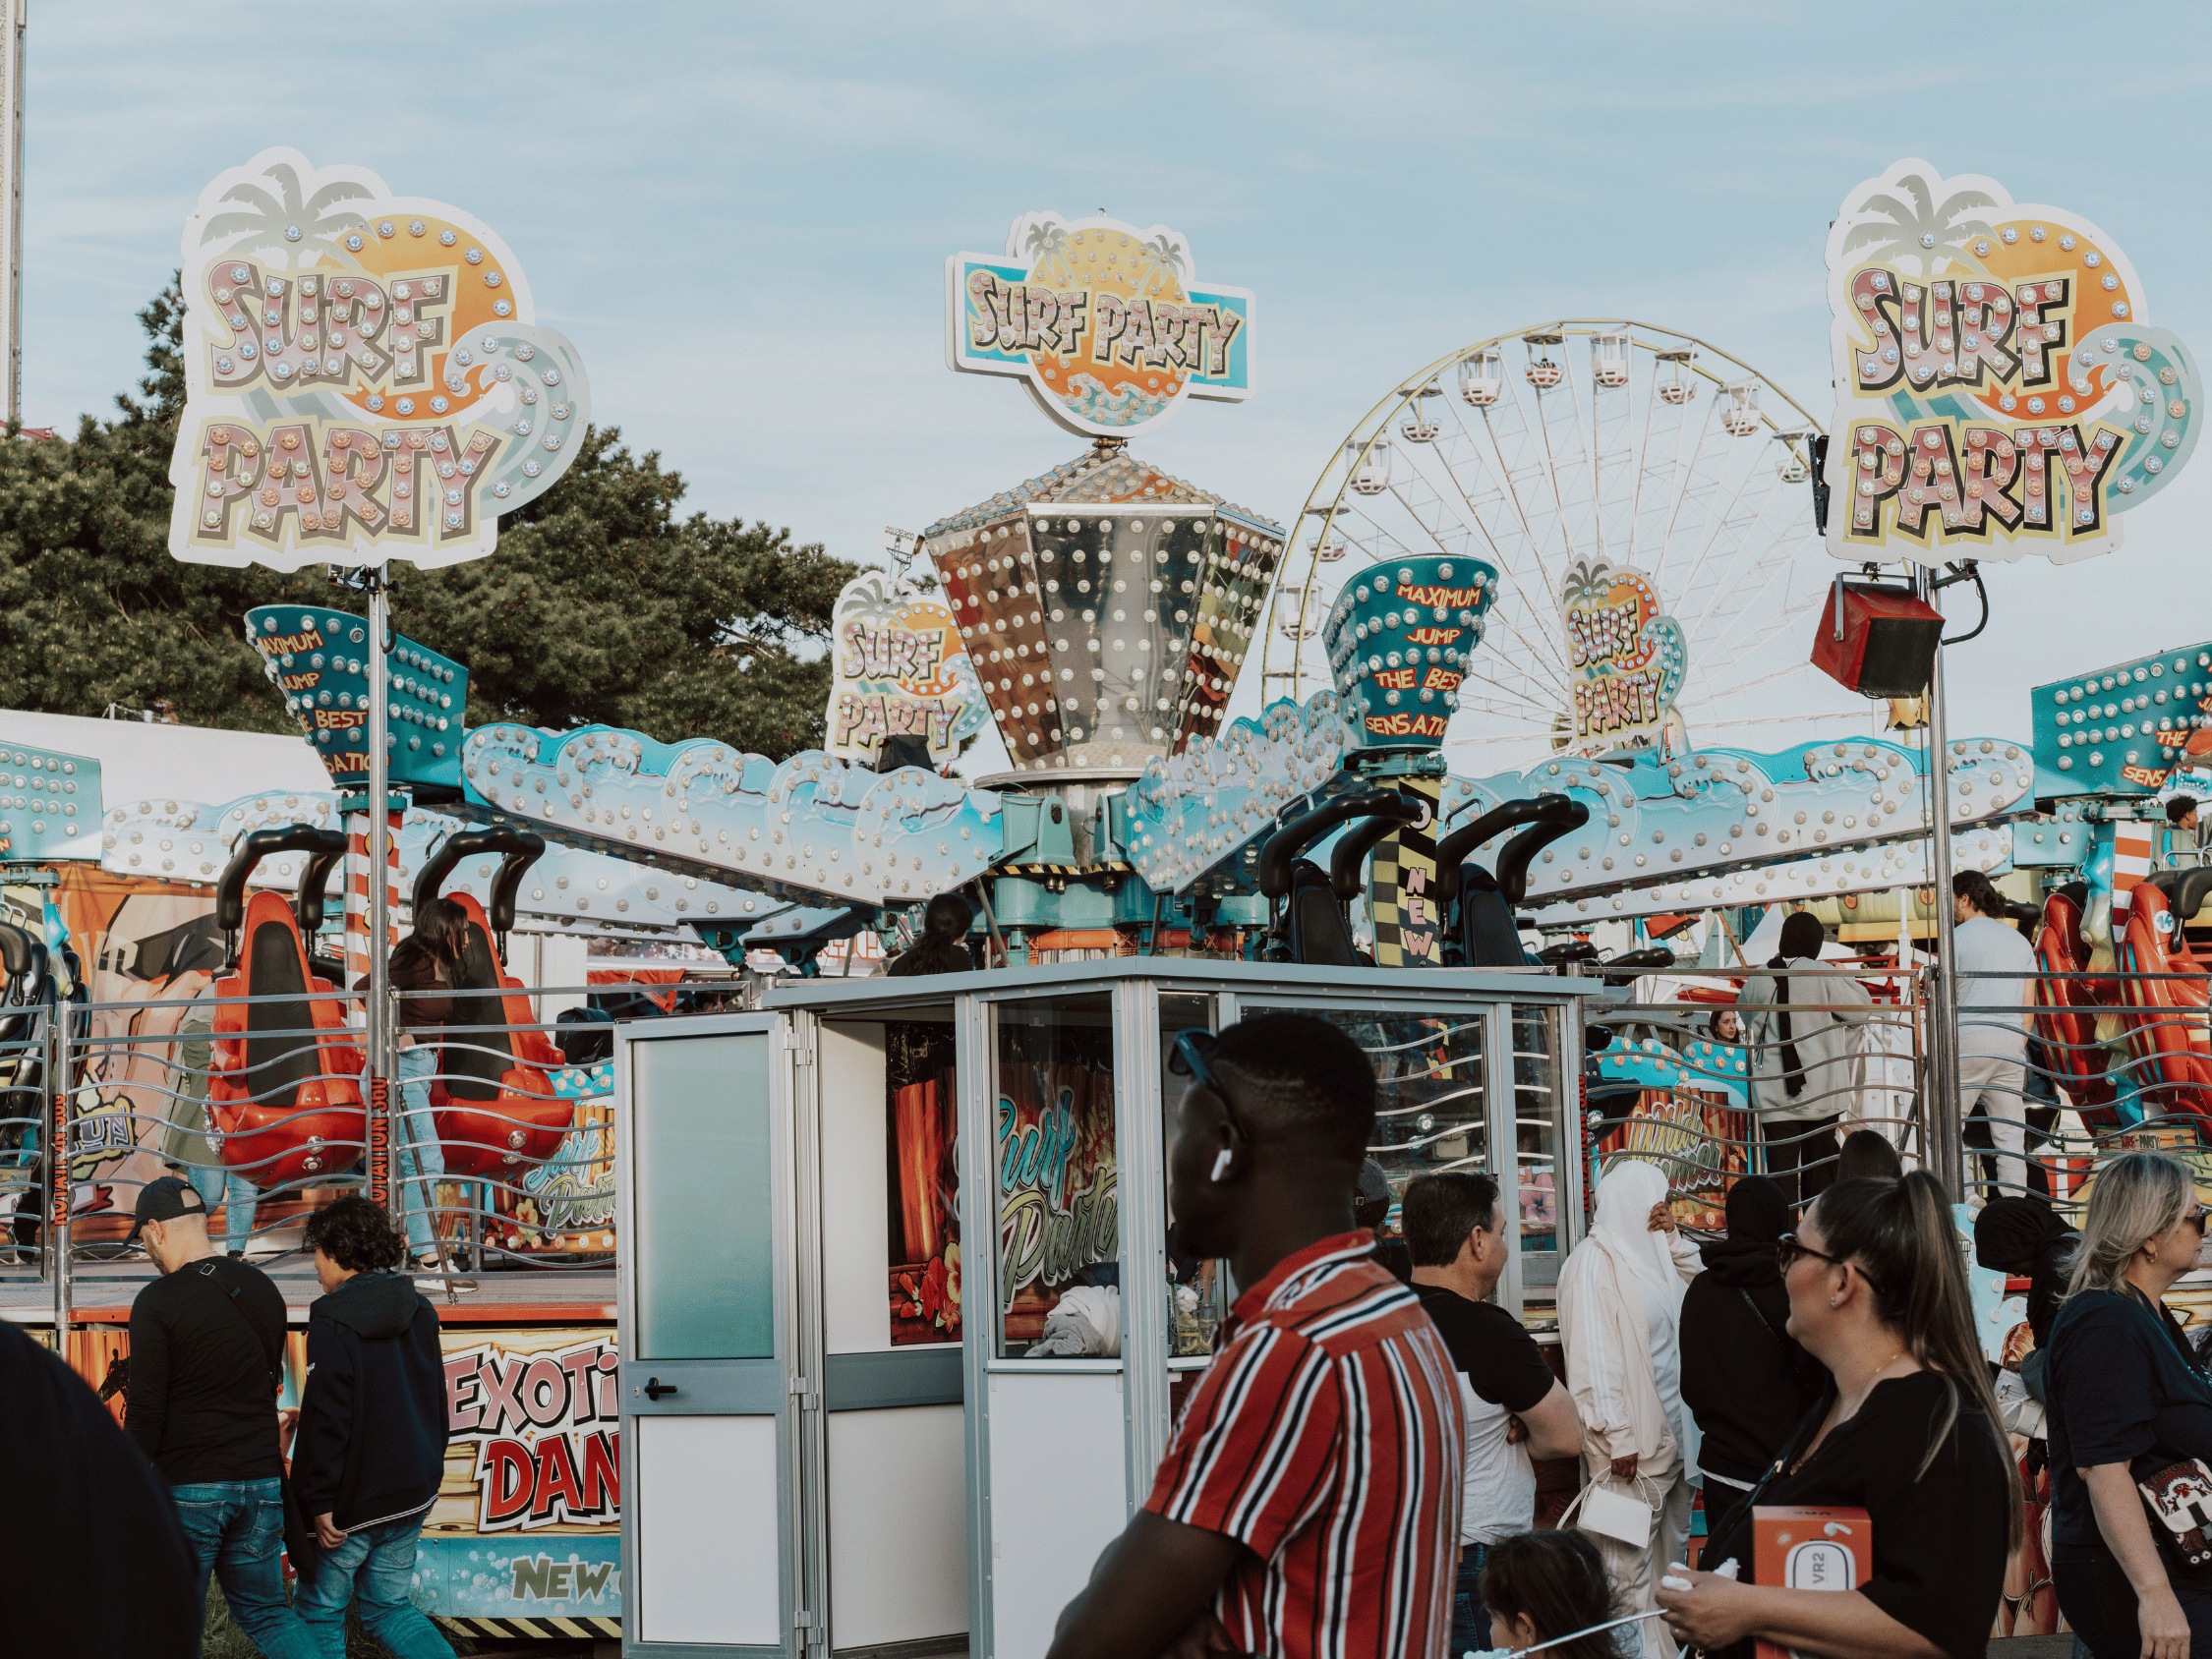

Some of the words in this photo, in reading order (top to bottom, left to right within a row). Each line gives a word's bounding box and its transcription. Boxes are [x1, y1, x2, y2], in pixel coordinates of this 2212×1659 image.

[206, 259, 450, 390] SURF
[968, 272, 1087, 355] SURF
[1094, 294, 1241, 375] PARTY
[1851, 267, 2069, 392] SURF
[198, 423, 502, 543] PARTY
[1852, 424, 2125, 539] PARTY
[1396, 584, 1483, 608] MAXIMUM
[843, 621, 943, 680] SURF
[1404, 628, 1463, 646] JUMP
[1568, 599, 1637, 668] SURF
[1372, 667, 1419, 689] THE
[1576, 669, 1662, 736] PARTY
[313, 709, 369, 729] BEST
[836, 694, 962, 750] PARTY
[2154, 729, 2189, 748] THE
[1404, 867, 1433, 956] NEW
[2156, 912, 2174, 930] 14
[372, 1116, 389, 1208] OTATION
[510, 1555, 615, 1604] NEW
